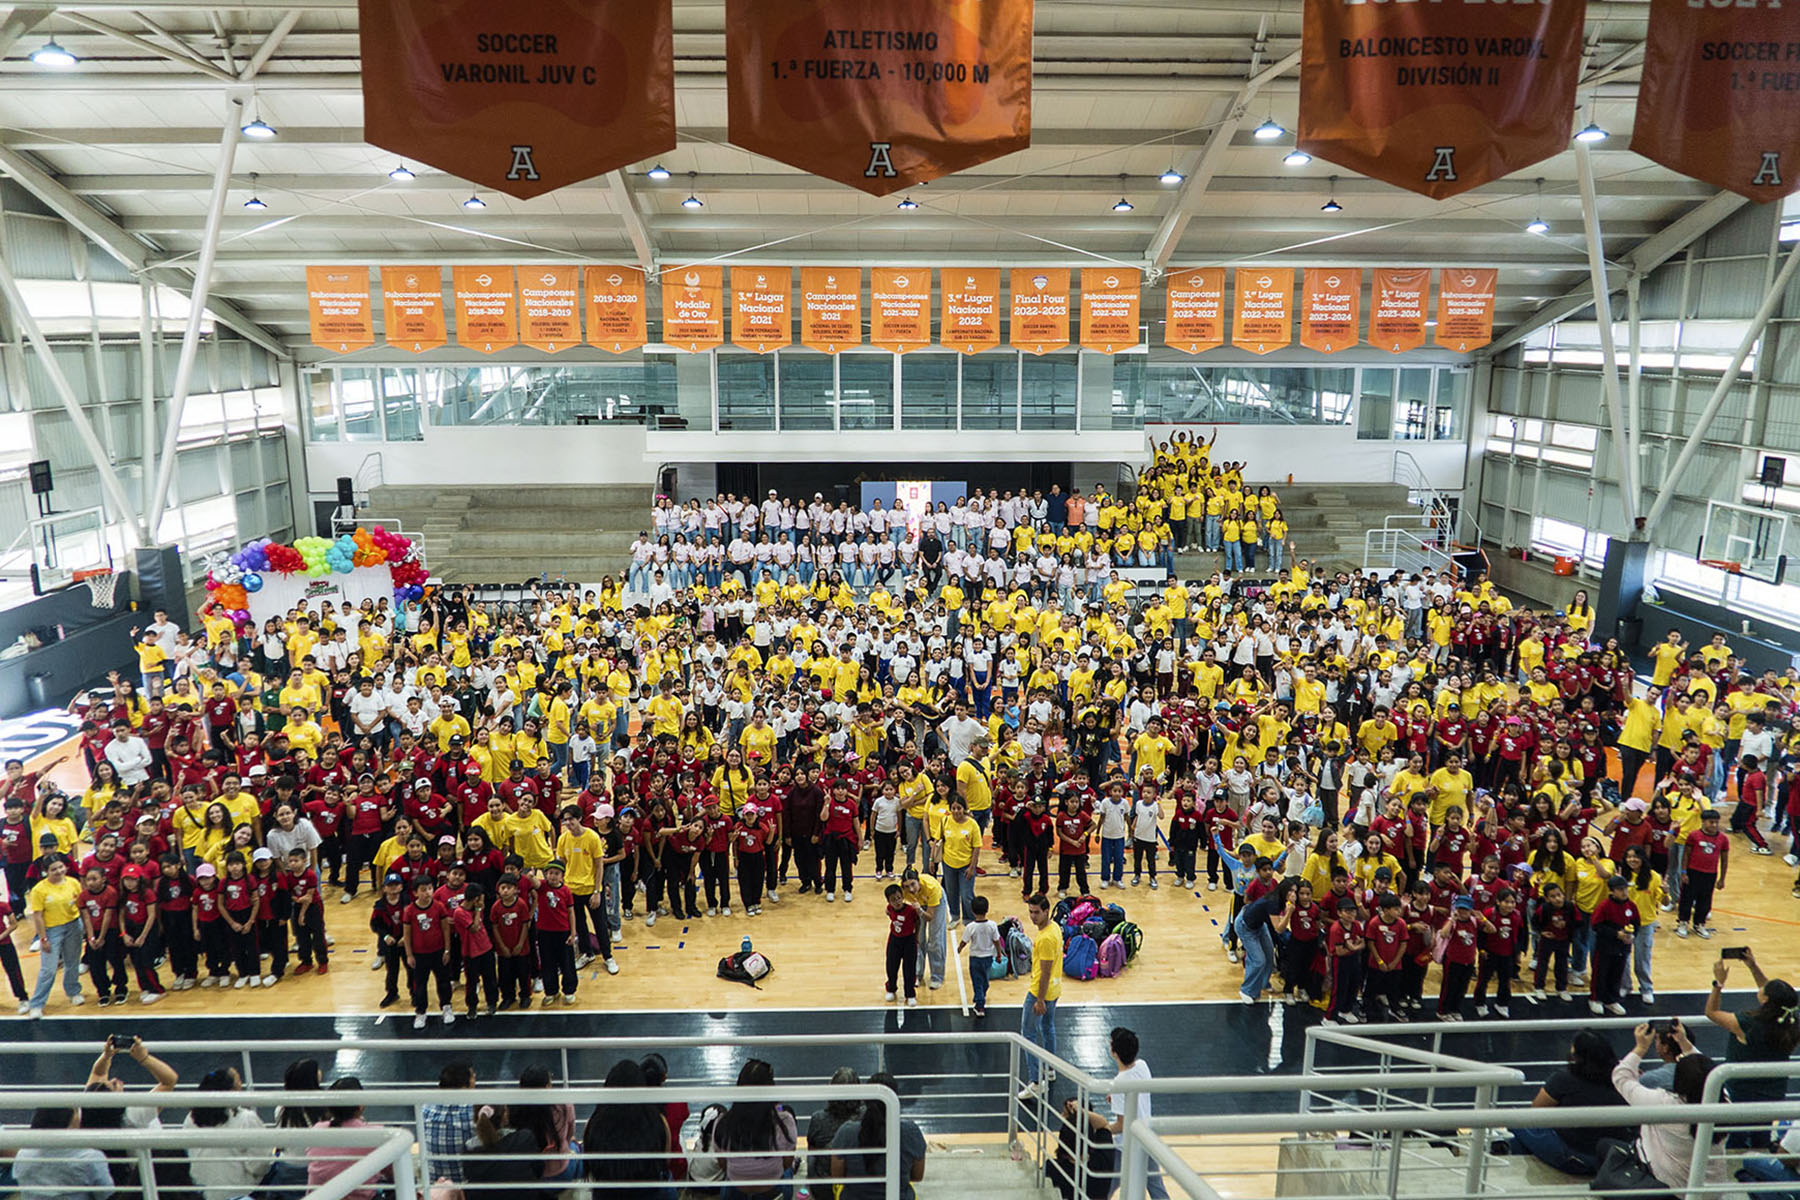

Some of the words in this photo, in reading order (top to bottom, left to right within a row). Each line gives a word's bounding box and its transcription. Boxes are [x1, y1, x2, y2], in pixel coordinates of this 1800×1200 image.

[477, 33, 558, 53] SOCCER
[824, 30, 937, 50] ATLETISMO
[1339, 37, 1468, 58] BALONCESTO
[1702, 42, 1779, 61] SOCCER
[441, 64, 529, 84] VARONIL
[537, 65, 575, 84] JUV
[583, 66, 596, 85] C
[771, 62, 796, 79] 1.ª
[805, 61, 880, 80] FUERZA
[904, 63, 966, 85] 10,000
[973, 65, 989, 83] M
[1397, 62, 1482, 86] DIVISIÓN
[1488, 67, 1499, 85] II
[1761, 72, 1800, 91] FUE
[506, 145, 540, 180] A
[864, 142, 897, 178] A
[1425, 146, 1457, 183] A
[1752, 151, 1782, 186] A
[523, 289, 575, 298] Campeones
[755, 292, 784, 303] Lugar
[805, 292, 857, 301] Campeones
[1171, 290, 1220, 299] Campeones
[1258, 291, 1283, 300] Lugar
[1326, 294, 1351, 302] Lugar
[1395, 291, 1420, 299] Lugar
[593, 295, 637, 303] 2019-2020
[964, 294, 993, 304] Lugar
[1015, 295, 1041, 303] Final
[1043, 295, 1065, 303] Four
[739, 304, 784, 312] Nacional
[948, 305, 992, 314] Nacional
[1014, 307, 1066, 315] 2022-2023
[679, 310, 690, 318] de
[691, 310, 707, 318] Oro
[1173, 310, 1217, 318] 2022-2023
[1241, 310, 1284, 318] 2022-2023
[750, 316, 772, 324] 2021
[959, 317, 982, 325] 2022
